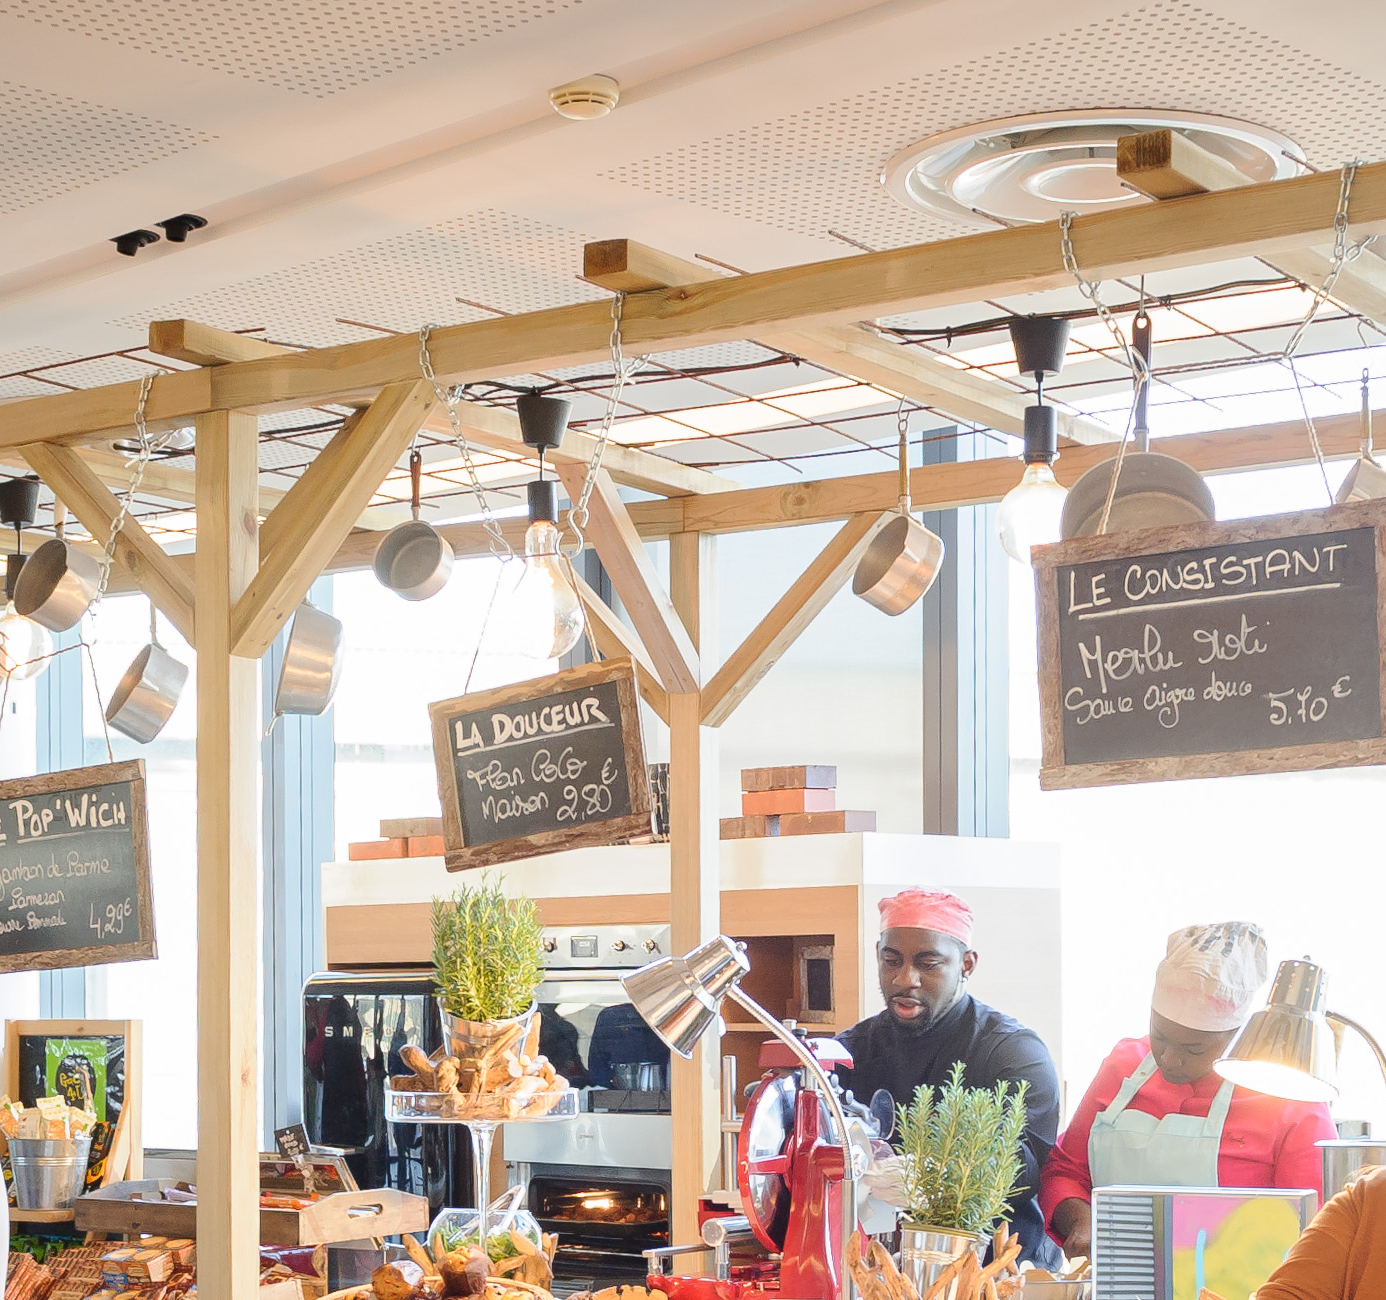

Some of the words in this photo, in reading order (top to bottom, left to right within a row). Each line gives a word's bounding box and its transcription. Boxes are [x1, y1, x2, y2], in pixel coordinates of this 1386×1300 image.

[1067, 570, 1112, 615] LE
[1124, 544, 1348, 602] CONSISTANT
[1078, 623, 1184, 694] Merlu
[454, 720, 484, 749] LA
[491, 697, 611, 744] DOUCEUR
[1065, 686, 1133, 725] Sauce
[1203, 671, 1252, 701] douce
[467, 760, 526, 792] Flan
[47, 853, 64, 879] de
[66, 851, 112, 878] Parme
